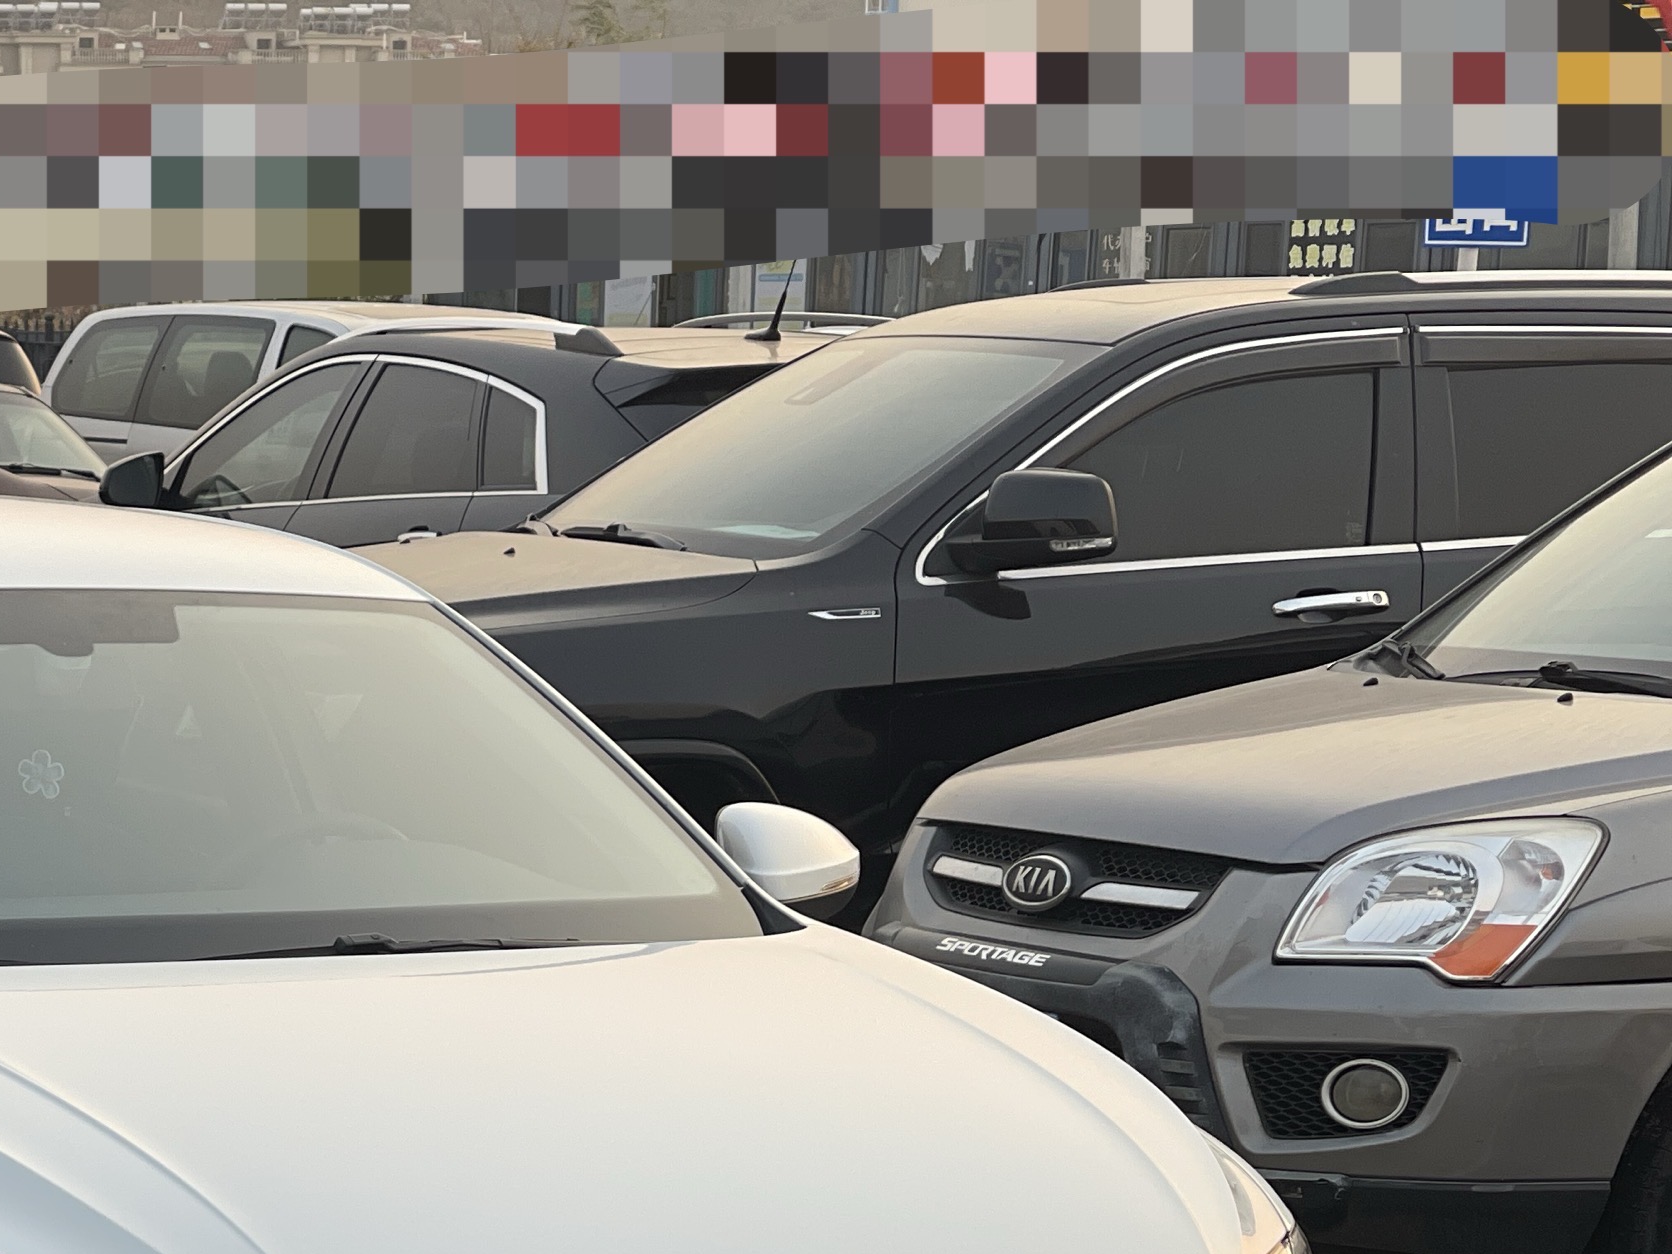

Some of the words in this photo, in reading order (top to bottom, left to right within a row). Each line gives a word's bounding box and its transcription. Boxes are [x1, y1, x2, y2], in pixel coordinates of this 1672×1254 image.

[1288, 243, 1355, 269] 免费评估
[1011, 865, 1057, 897] KIA
[935, 936, 1052, 967] SPORTAGE
